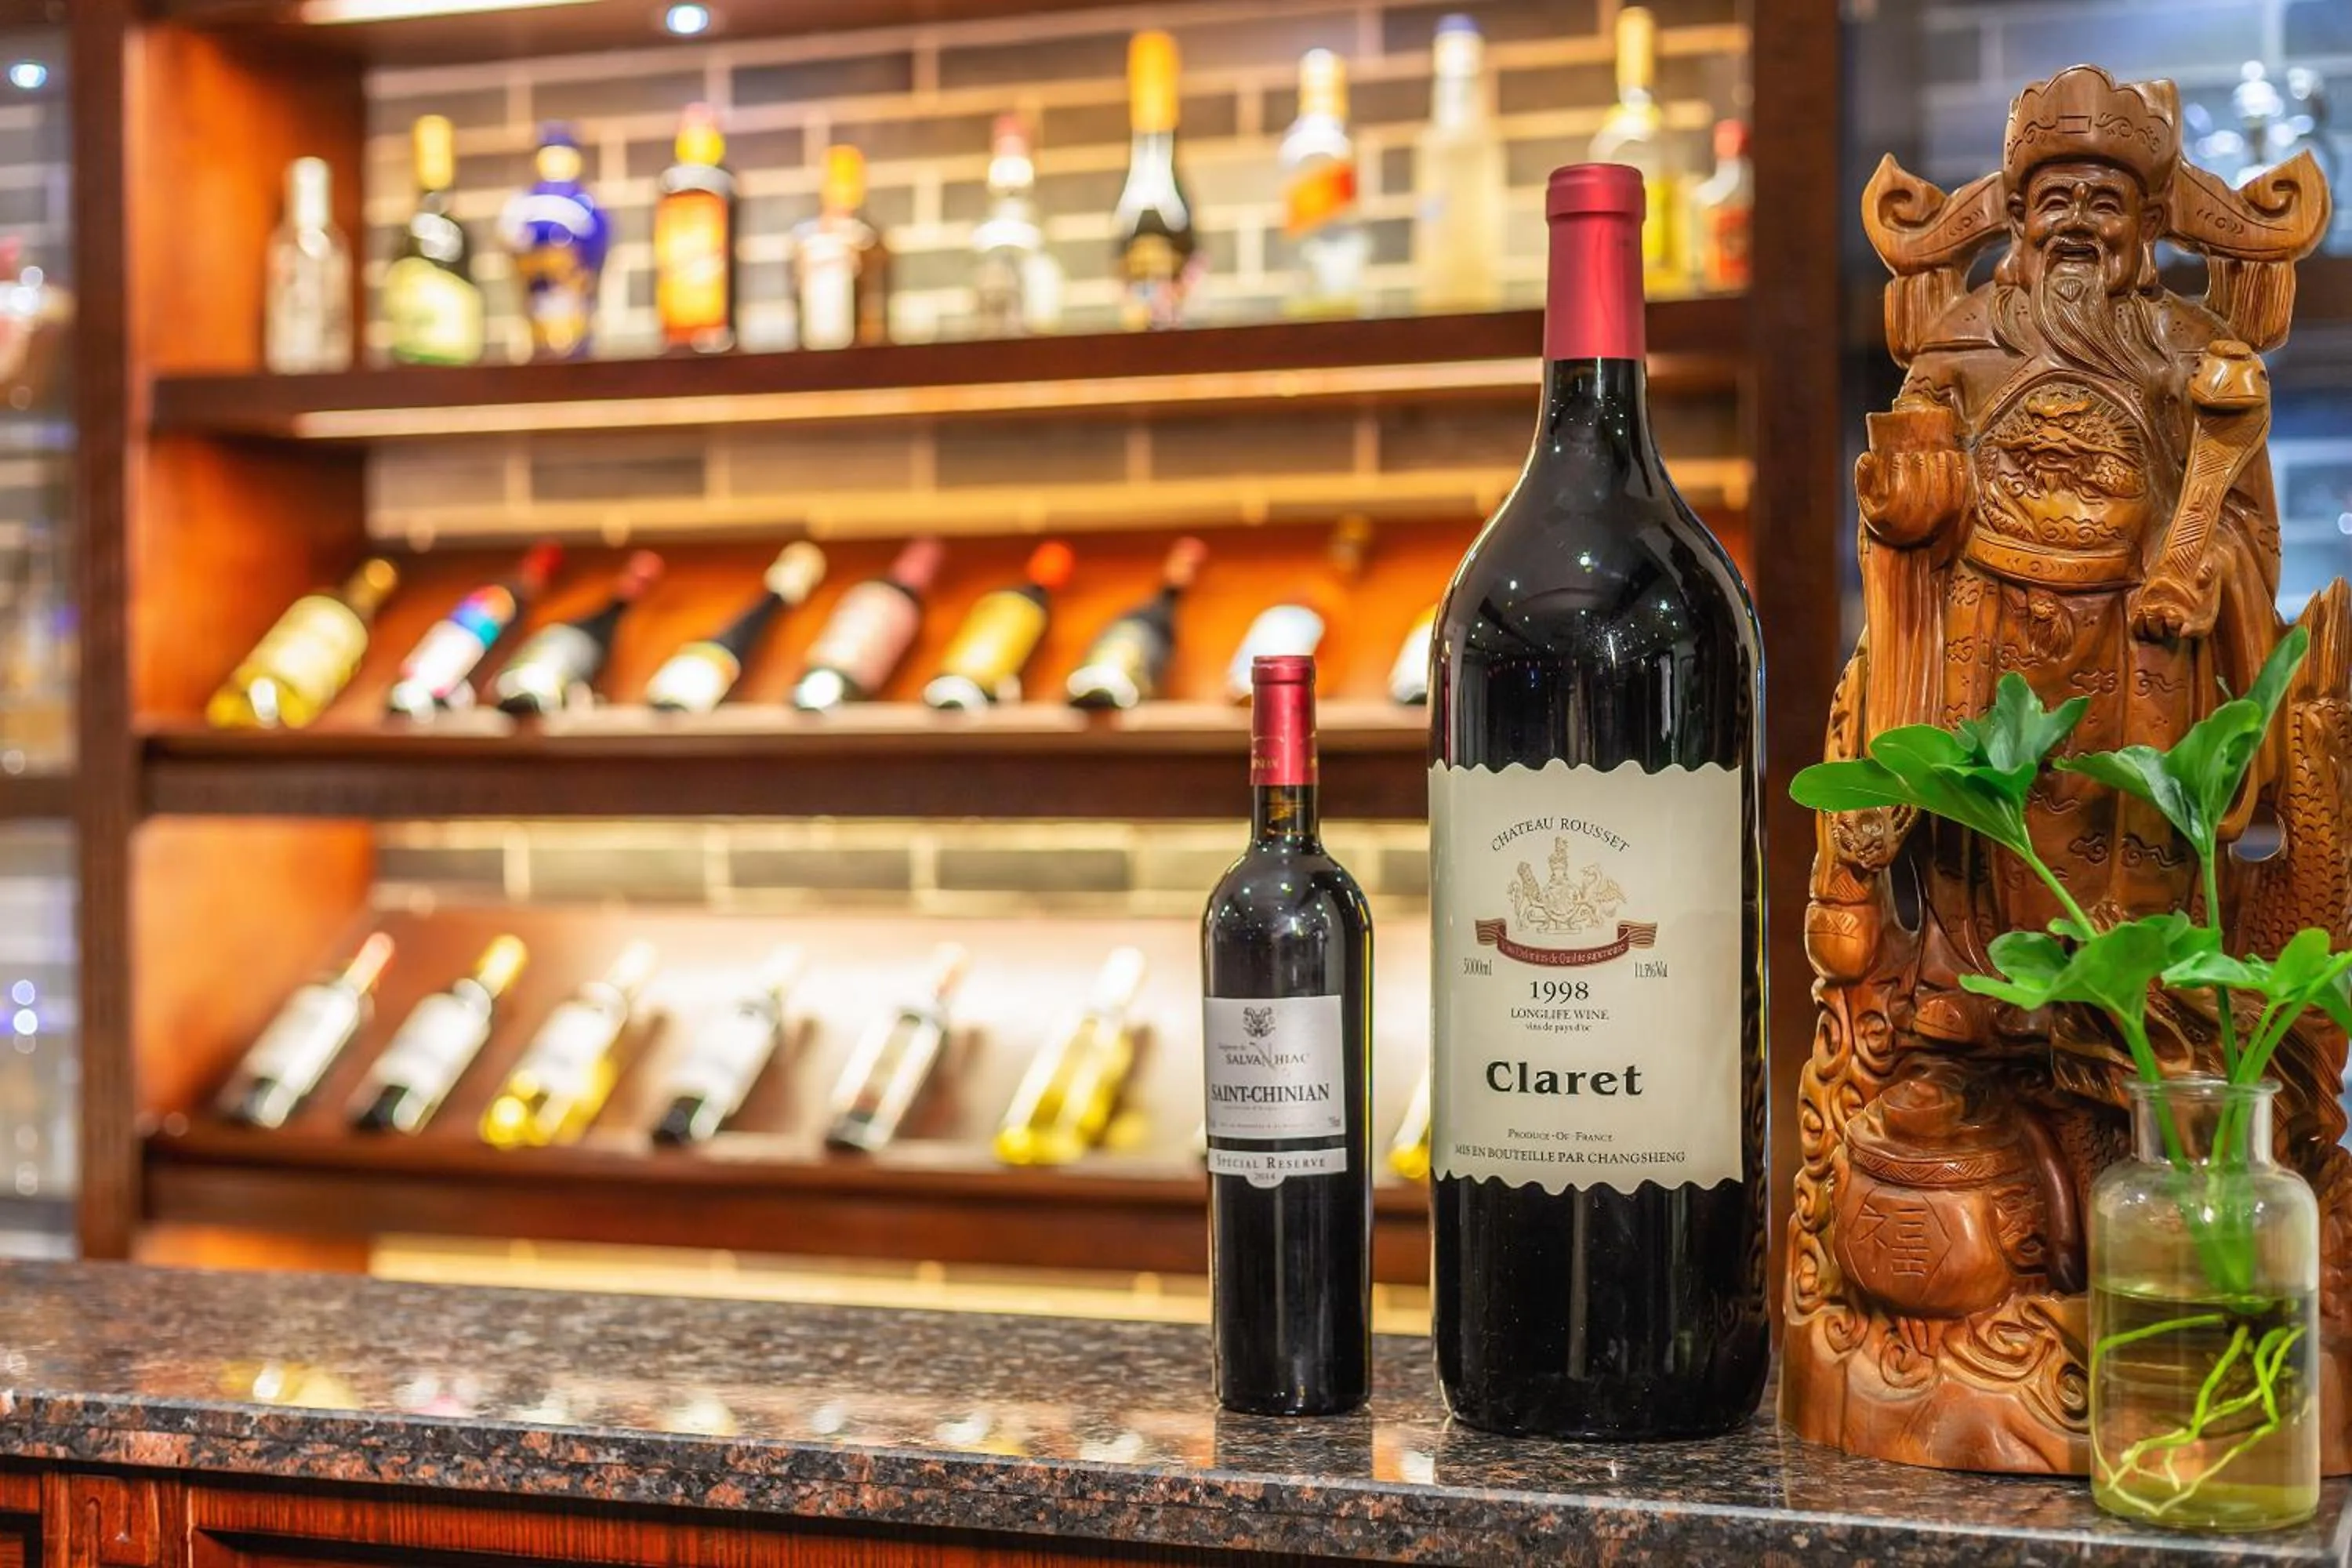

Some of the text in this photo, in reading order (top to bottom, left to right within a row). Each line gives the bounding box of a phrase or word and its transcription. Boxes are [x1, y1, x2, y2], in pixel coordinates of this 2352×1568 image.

[1491, 816, 1630, 852] CHATEAU ROUSSET
[1530, 980, 1589, 1004] 1998
[1511, 1007, 1610, 1020] LONGLIFE WINE
[1486, 1061, 1644, 1096] Claret
[1211, 1083, 1330, 1103] SAINT-CHINIAN
[1455, 1144, 1686, 1165] MIS EN BOUTEILLE PAR CHANGSHENG
